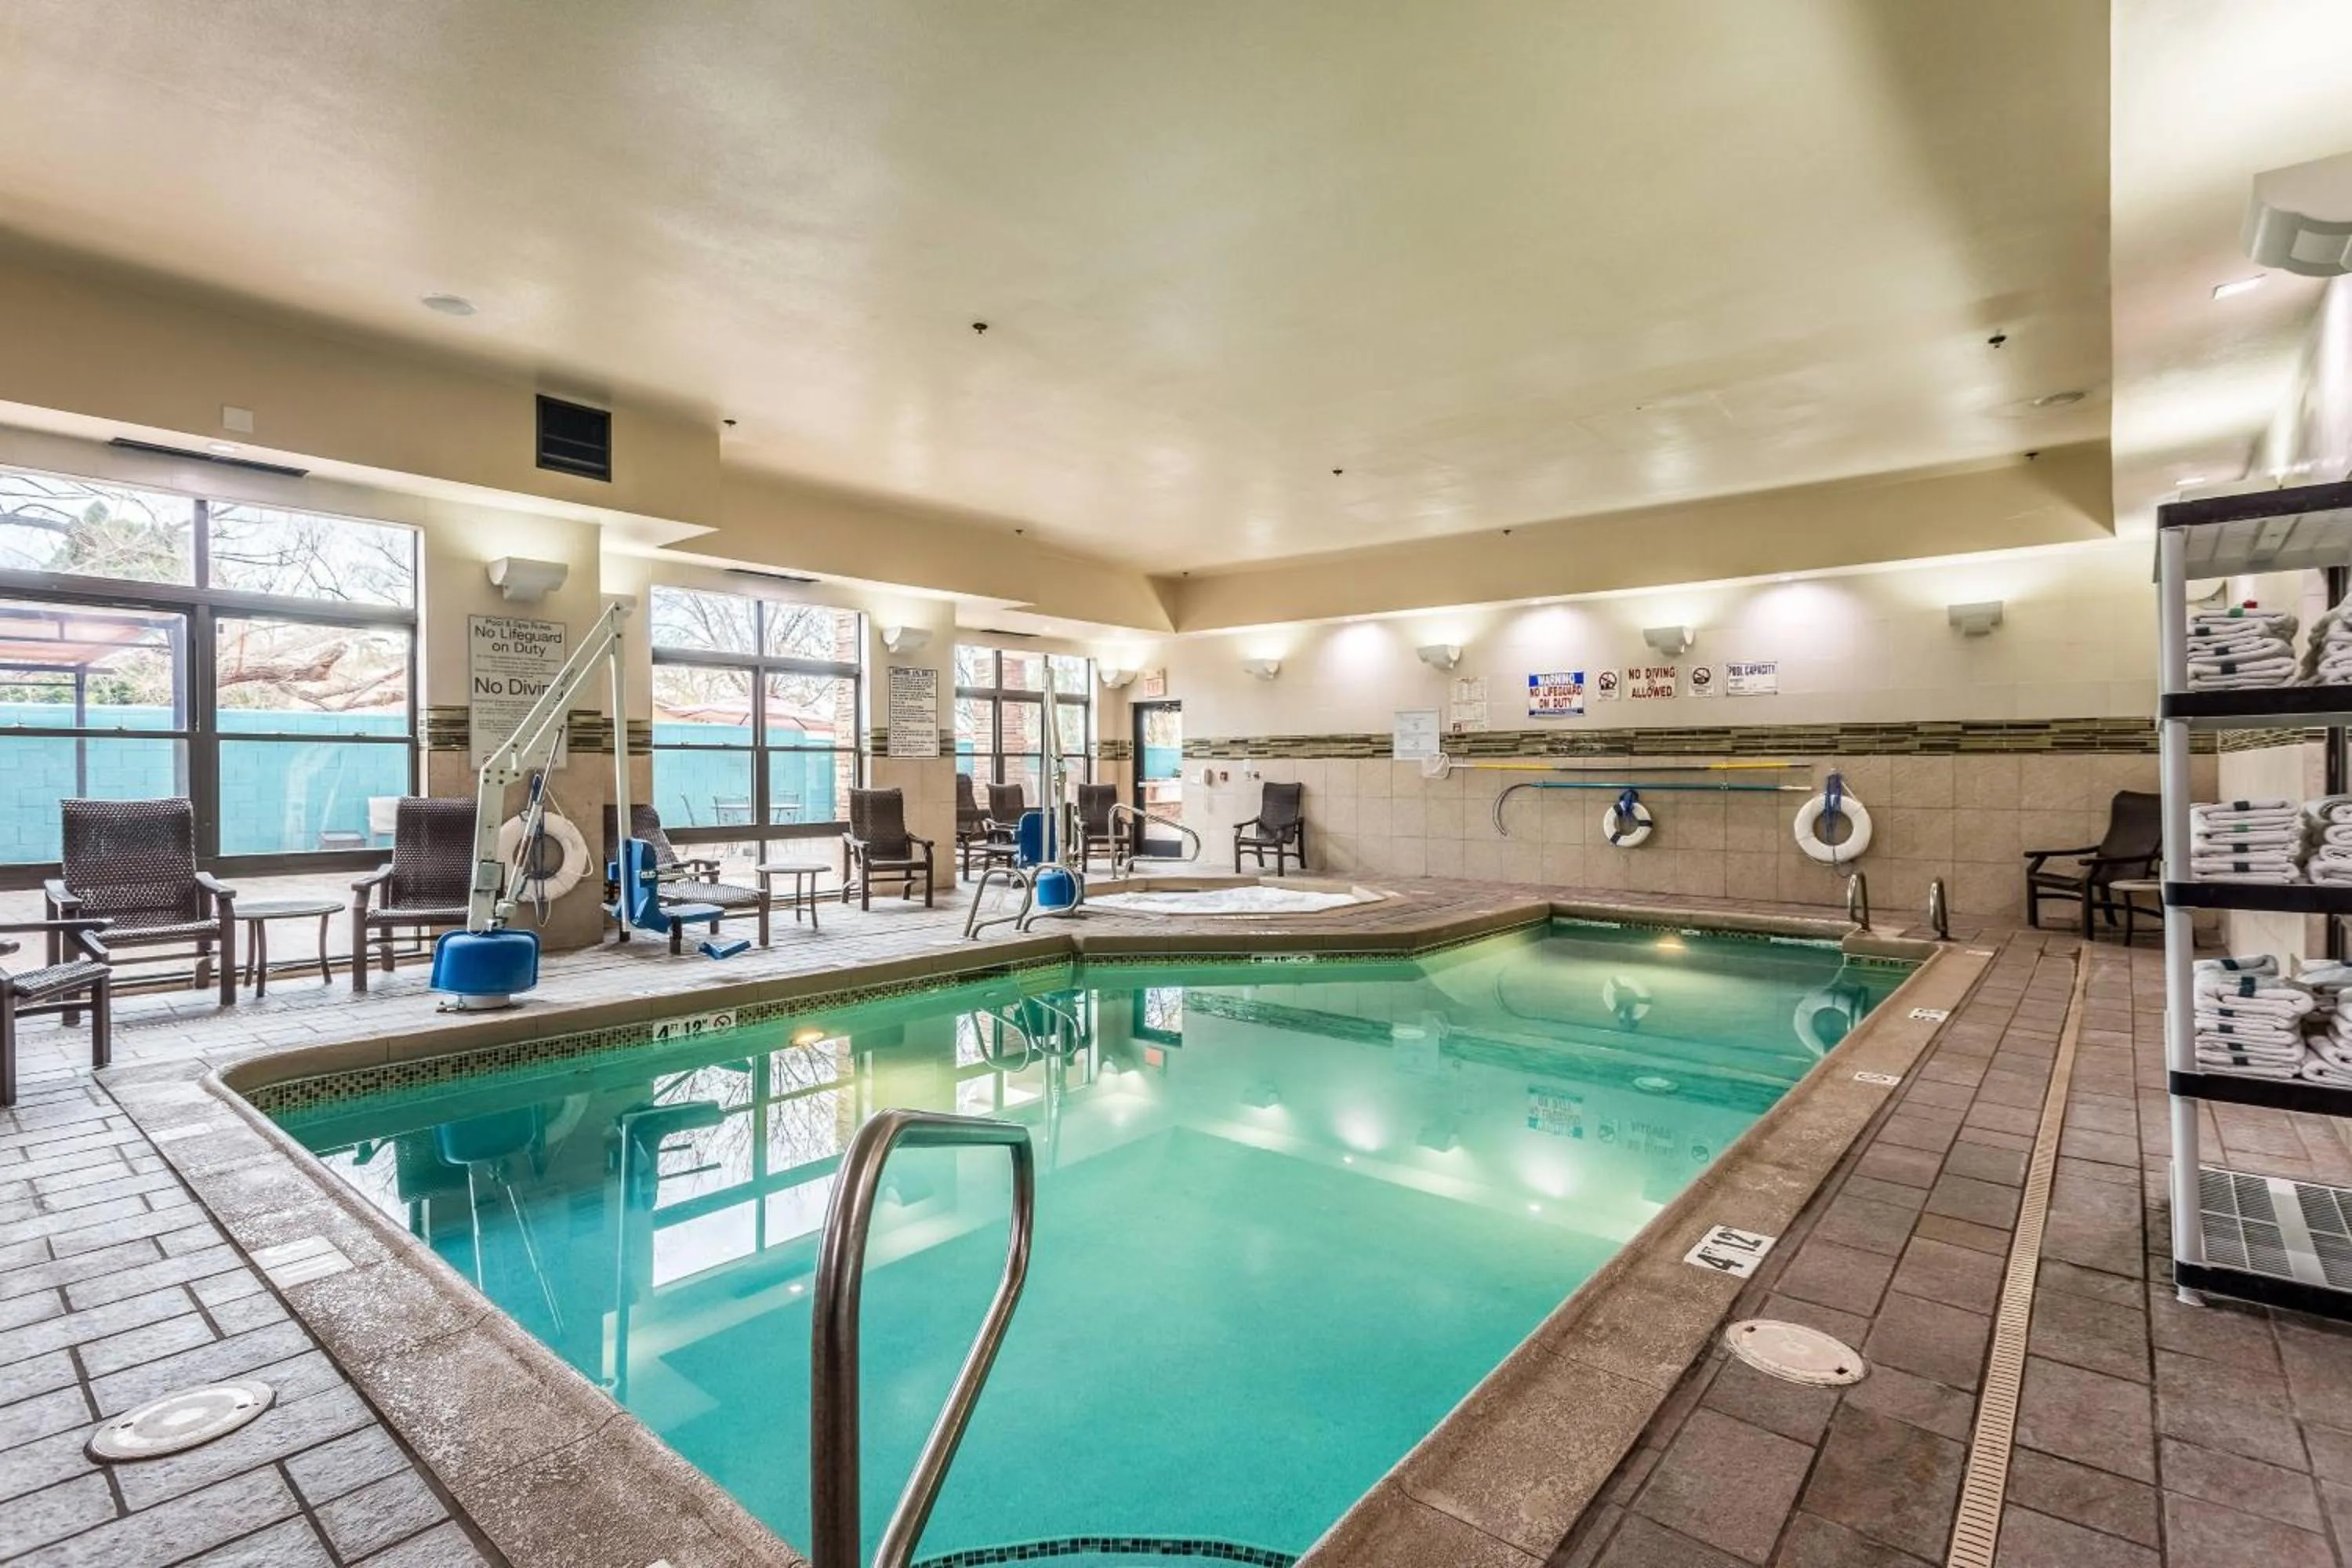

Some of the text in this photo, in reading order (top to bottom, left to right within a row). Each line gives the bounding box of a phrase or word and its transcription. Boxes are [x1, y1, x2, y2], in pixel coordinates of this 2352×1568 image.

[474, 625, 562, 644] No Lifeguard
[492, 642, 546, 658] on Duty
[1628, 666, 1675, 680] NO DIVING
[474, 677, 503, 694] No
[1632, 685, 1672, 698] ALLOWED
[1554, 697, 1573, 707] DUTY
[1697, 1254, 1744, 1270] 4
